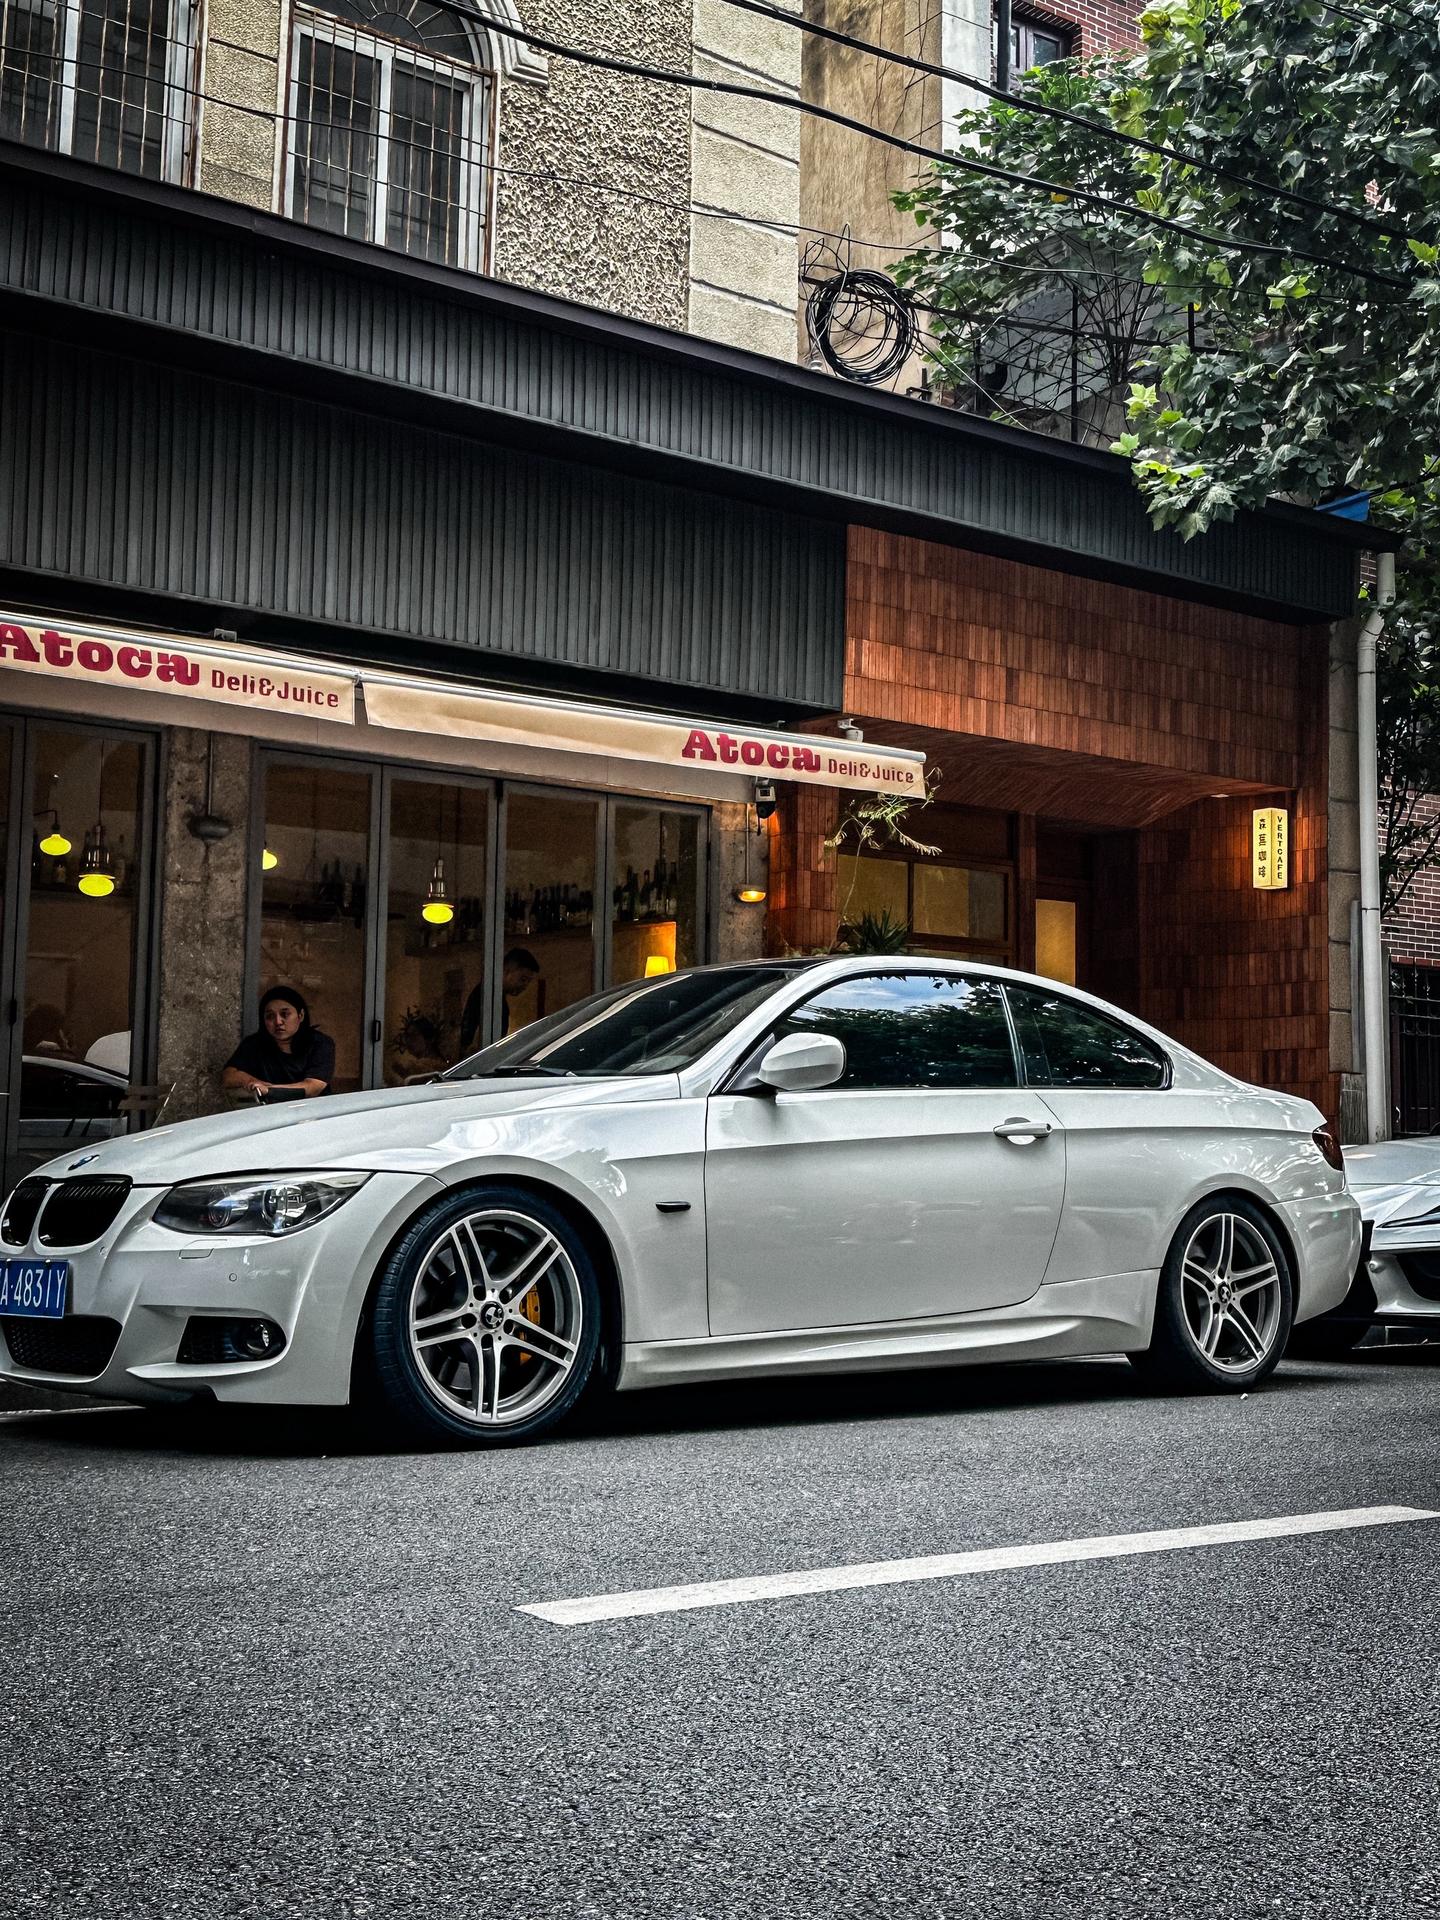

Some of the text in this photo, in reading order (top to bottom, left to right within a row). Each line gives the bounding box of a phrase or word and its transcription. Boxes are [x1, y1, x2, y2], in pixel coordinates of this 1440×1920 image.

[0, 623, 340, 708] Atoca Deli&Juice
[681, 729, 915, 784] Atoca Deli&Juice
[0, 1267, 66, 1310] A·4831Y
